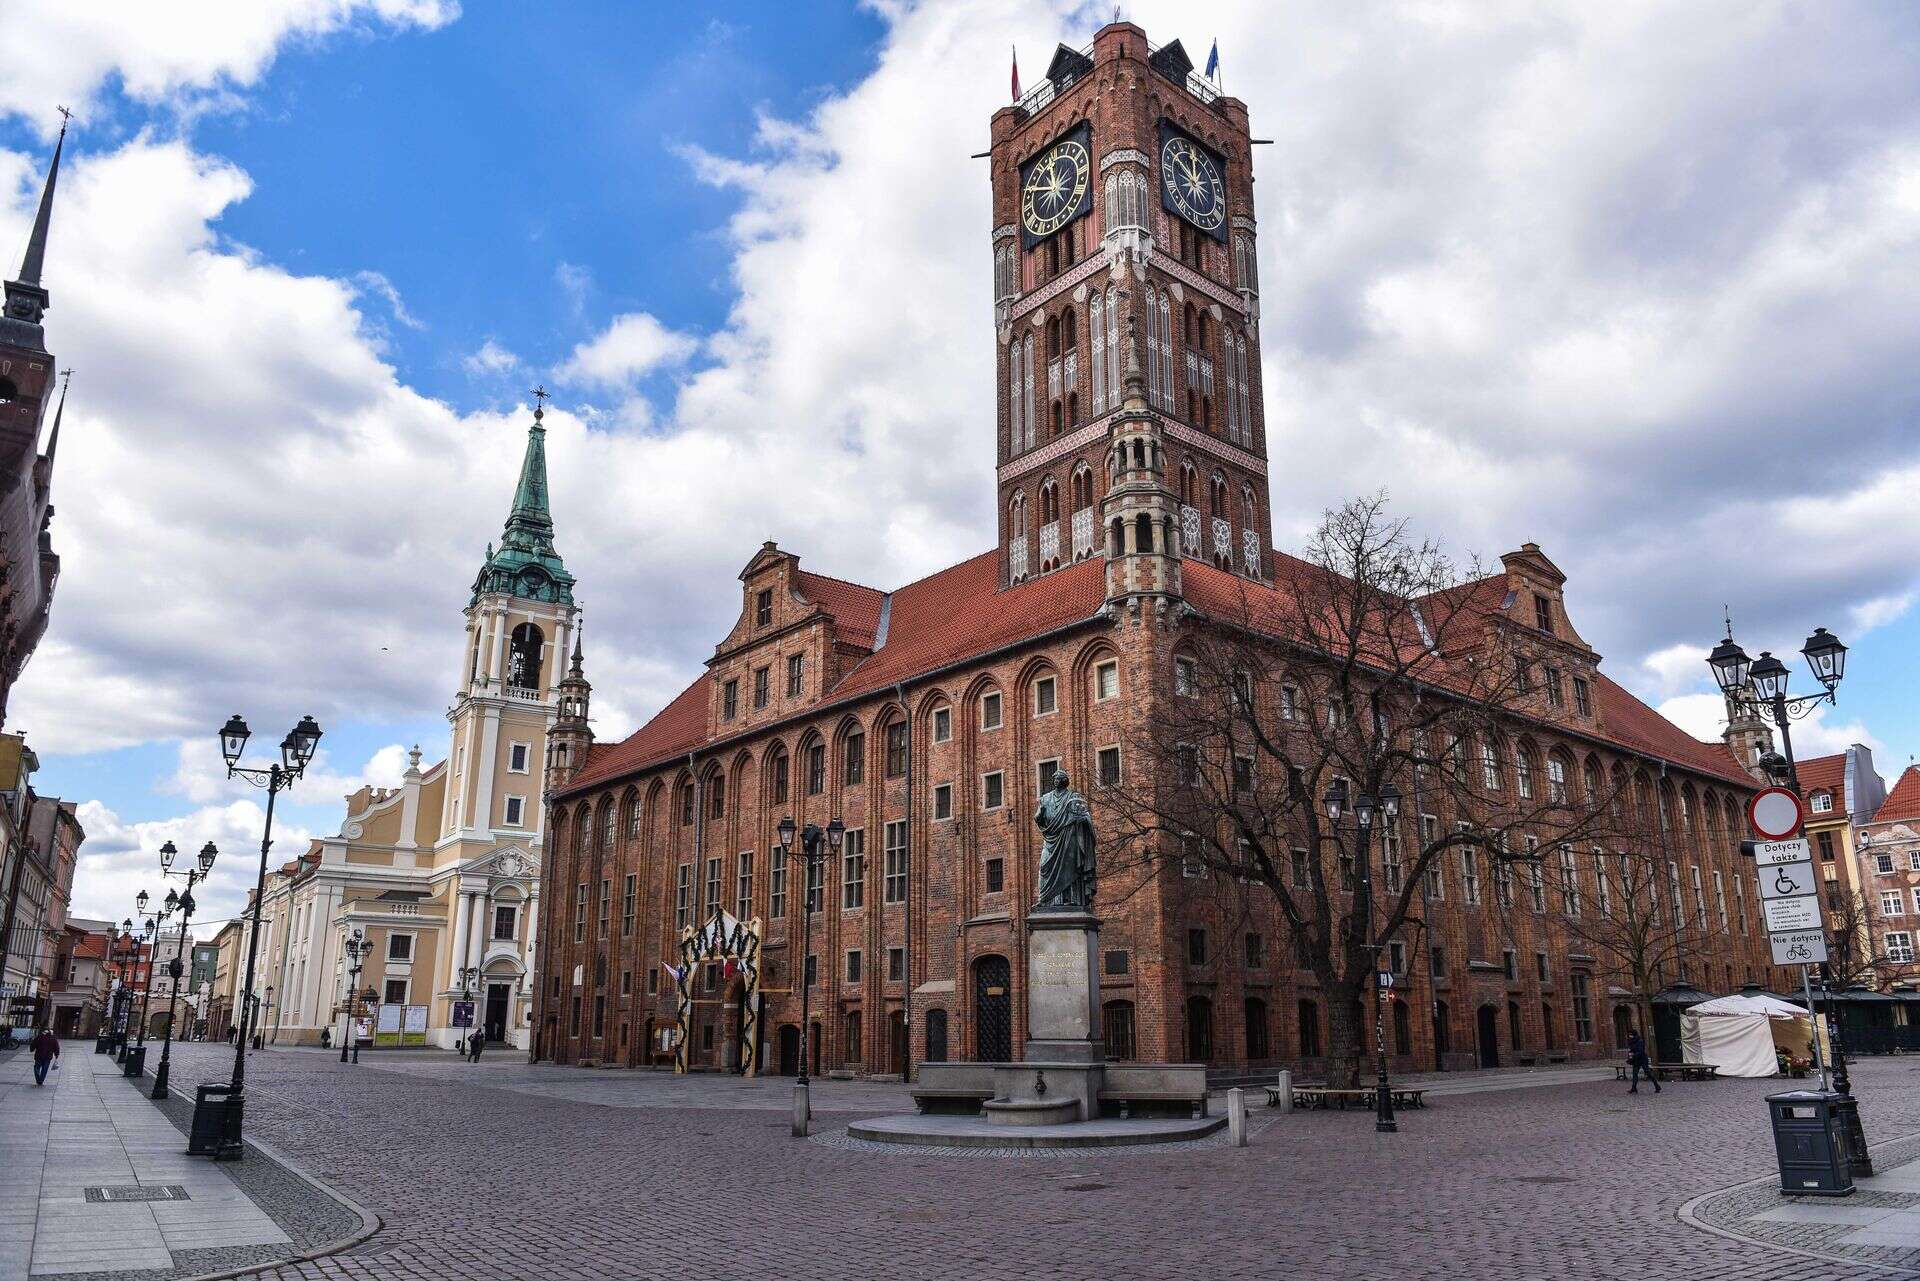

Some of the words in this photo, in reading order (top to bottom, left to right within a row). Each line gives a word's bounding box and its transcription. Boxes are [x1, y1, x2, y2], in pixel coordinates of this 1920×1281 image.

[1765, 842, 1801, 853] Dotyczy
[1771, 853, 1798, 862] także
[1773, 936, 1787, 944] Nie
[1791, 934, 1822, 943] dotyczy
